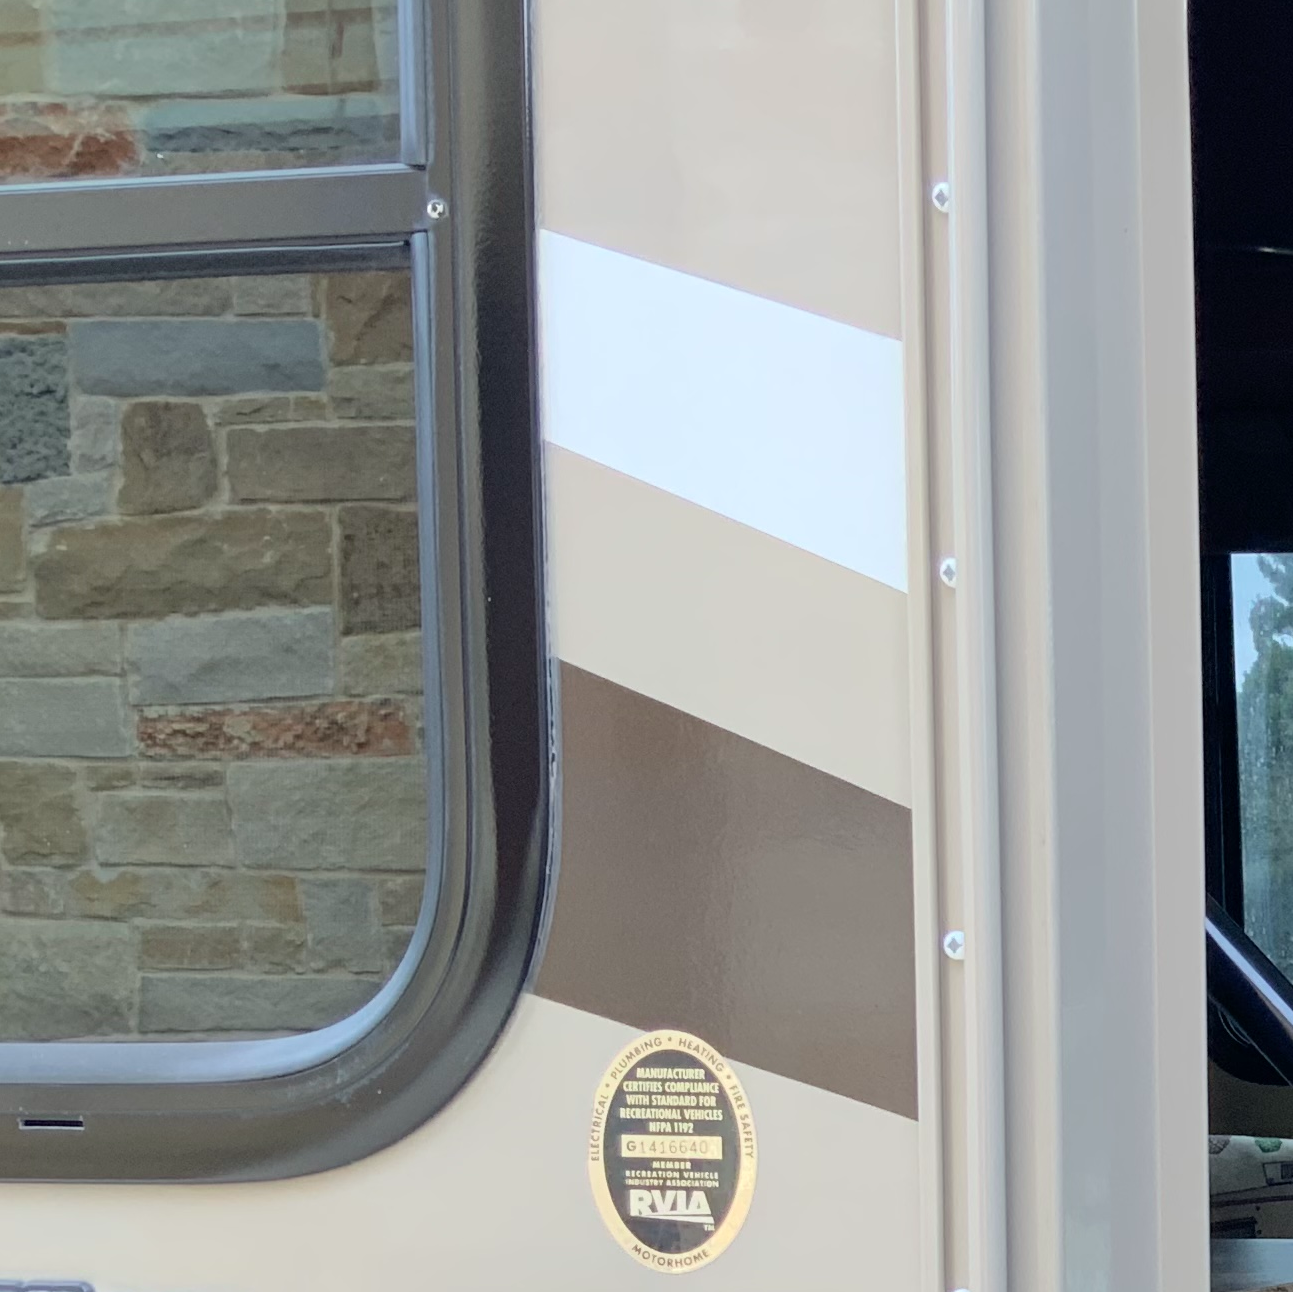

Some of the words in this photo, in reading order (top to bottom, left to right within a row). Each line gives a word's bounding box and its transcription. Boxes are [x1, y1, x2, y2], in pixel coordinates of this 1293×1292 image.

[636, 1067, 706, 1080] MANUFACTURER
[622, 1081, 663, 1092] CERTIFIES
[664, 1082, 720, 1094] COMPLIANCE
[591, 1094, 609, 1162] ELECTRICAL
[610, 1037, 662, 1080] PLUMBING
[678, 1037, 725, 1073] HEATING
[729, 1084, 746, 1110] FIRE
[740, 1113, 754, 1159] SAFETY
[626, 1094, 650, 1106] WITH
[651, 1095, 697, 1107] STANDARD
[699, 1096, 717, 1107] FOR
[619, 1107, 682, 1120] RECREATIONAL
[683, 1109, 723, 1121] VEHICLES
[649, 1121, 672, 1133] NFPA
[673, 1122, 694, 1134] 1192
[652, 1161, 692, 1170] MEMBER
[625, 1170, 680, 1179] RECREATION
[683, 1171, 719, 1180] VEHICLE
[625, 1179, 664, 1187] INDUSTRY
[666, 1180, 720, 1188] ASSOCIATION
[629, 1189, 712, 1216] RVIA
[632, 1244, 709, 1268] MOTORHOME
